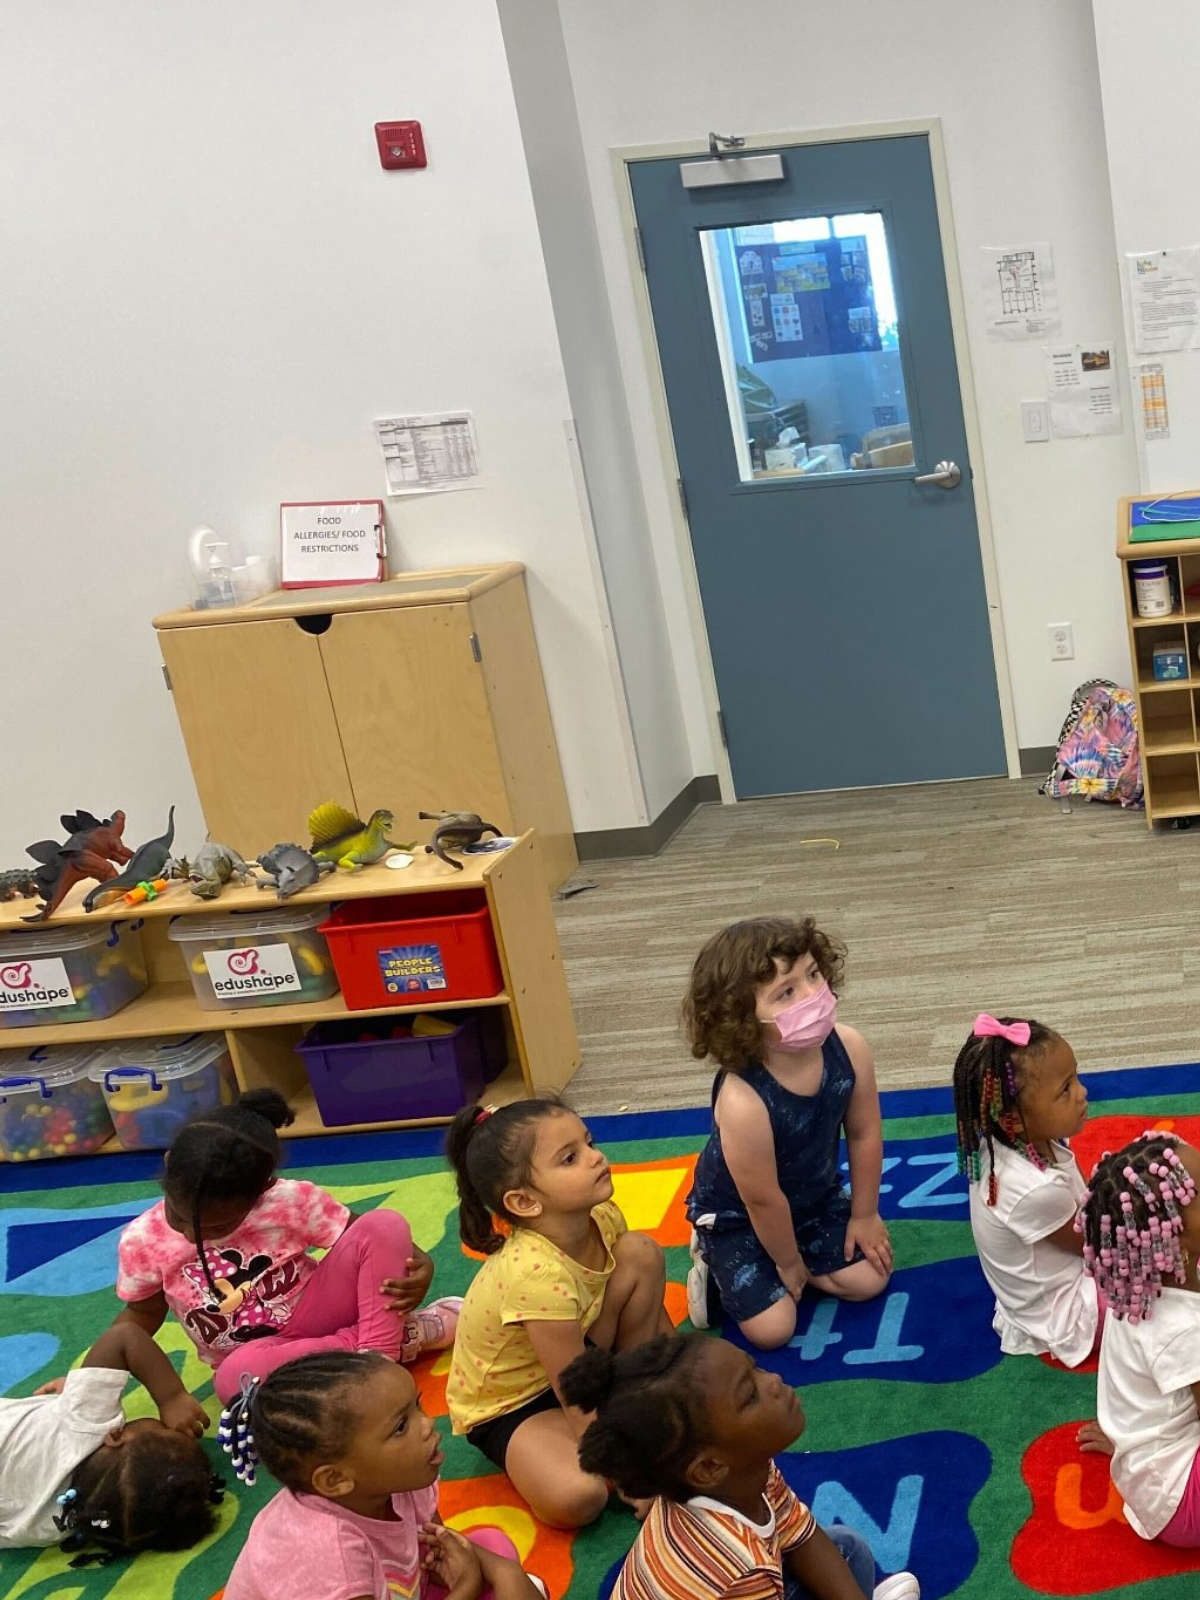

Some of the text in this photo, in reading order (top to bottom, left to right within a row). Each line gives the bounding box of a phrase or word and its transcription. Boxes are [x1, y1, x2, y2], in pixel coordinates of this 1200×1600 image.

[317, 517, 342, 525] FOOD
[342, 530, 366, 538] FOOD
[301, 544, 359, 553] RESTRICTIONS
[388, 957, 433, 968] PEOPLE
[384, 966, 441, 977] BUILDERS
[215, 974, 295, 991] edushape
[0, 989, 69, 1003] dushape
